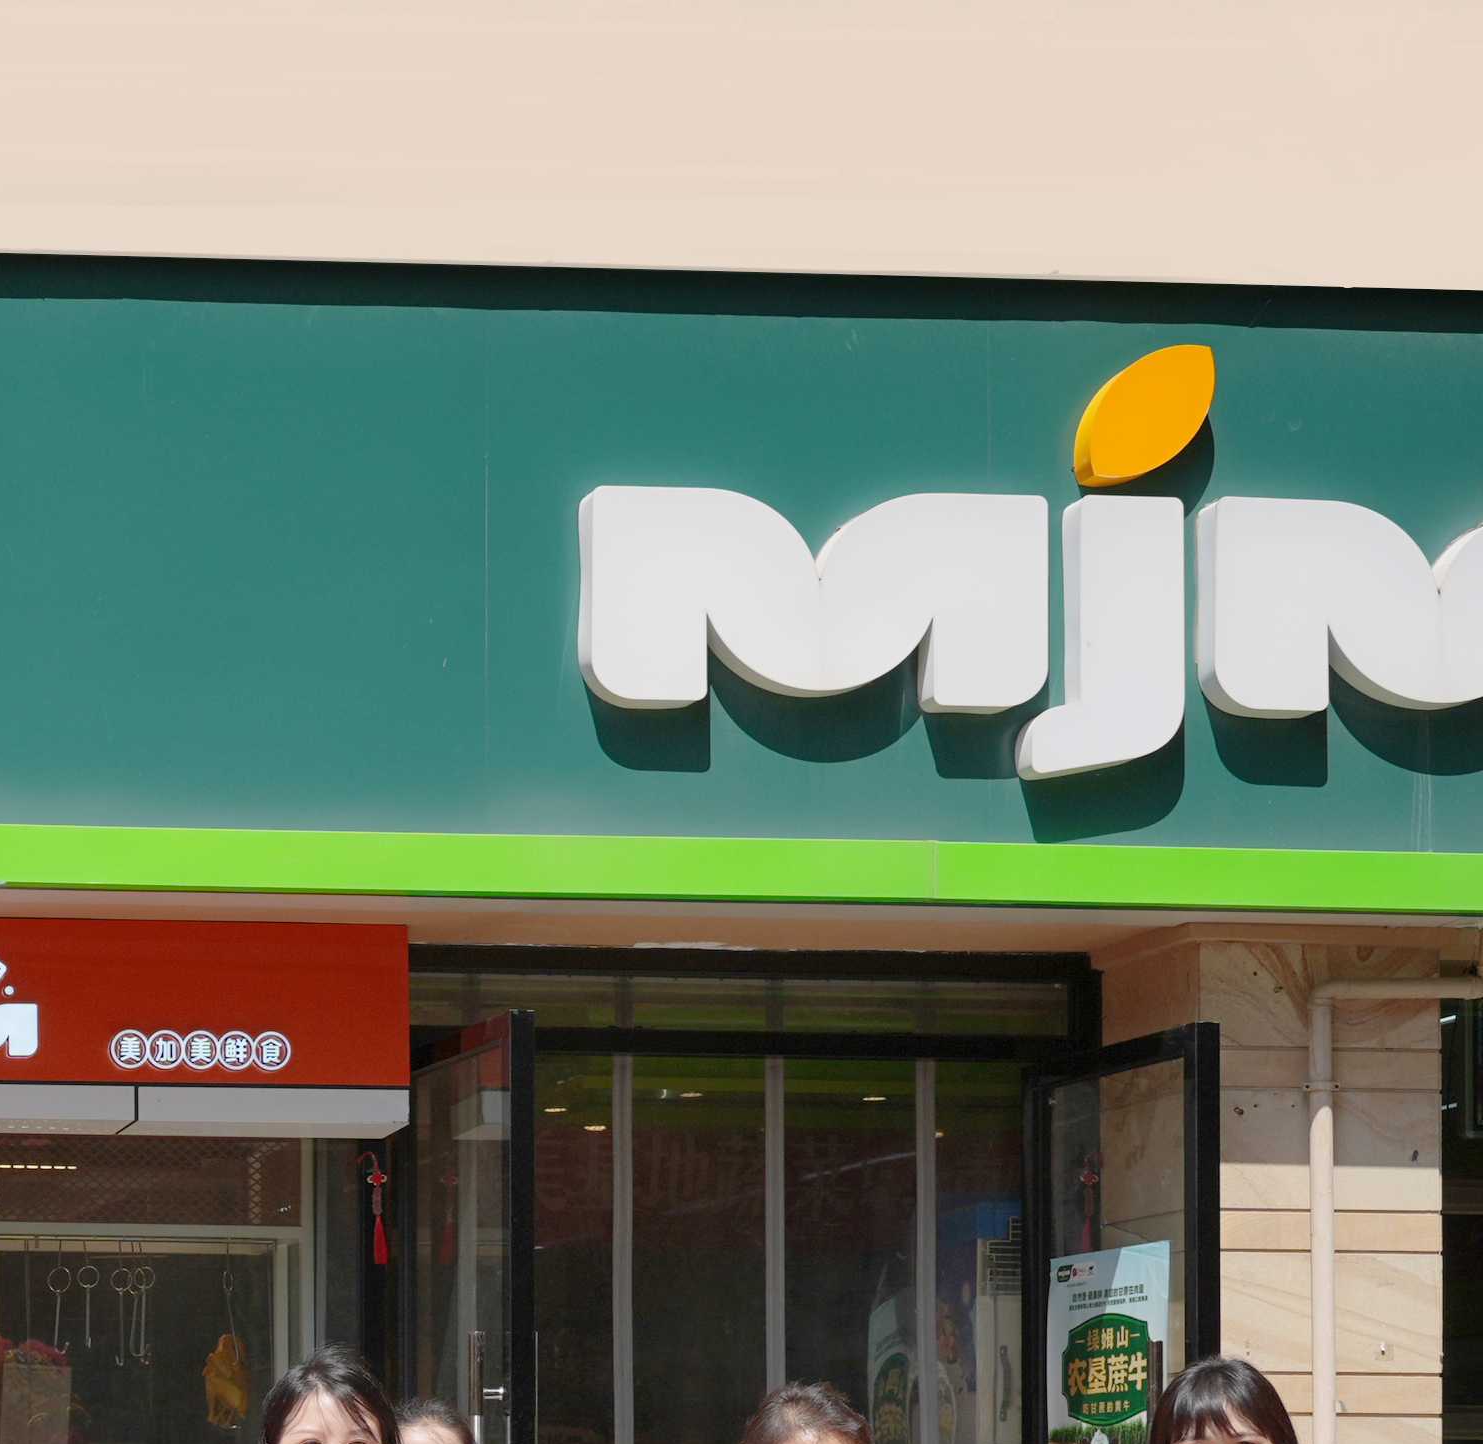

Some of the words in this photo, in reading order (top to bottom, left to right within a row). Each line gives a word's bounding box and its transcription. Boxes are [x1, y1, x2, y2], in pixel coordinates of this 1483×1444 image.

[115, 1034, 286, 1067] 美加美鲜食
